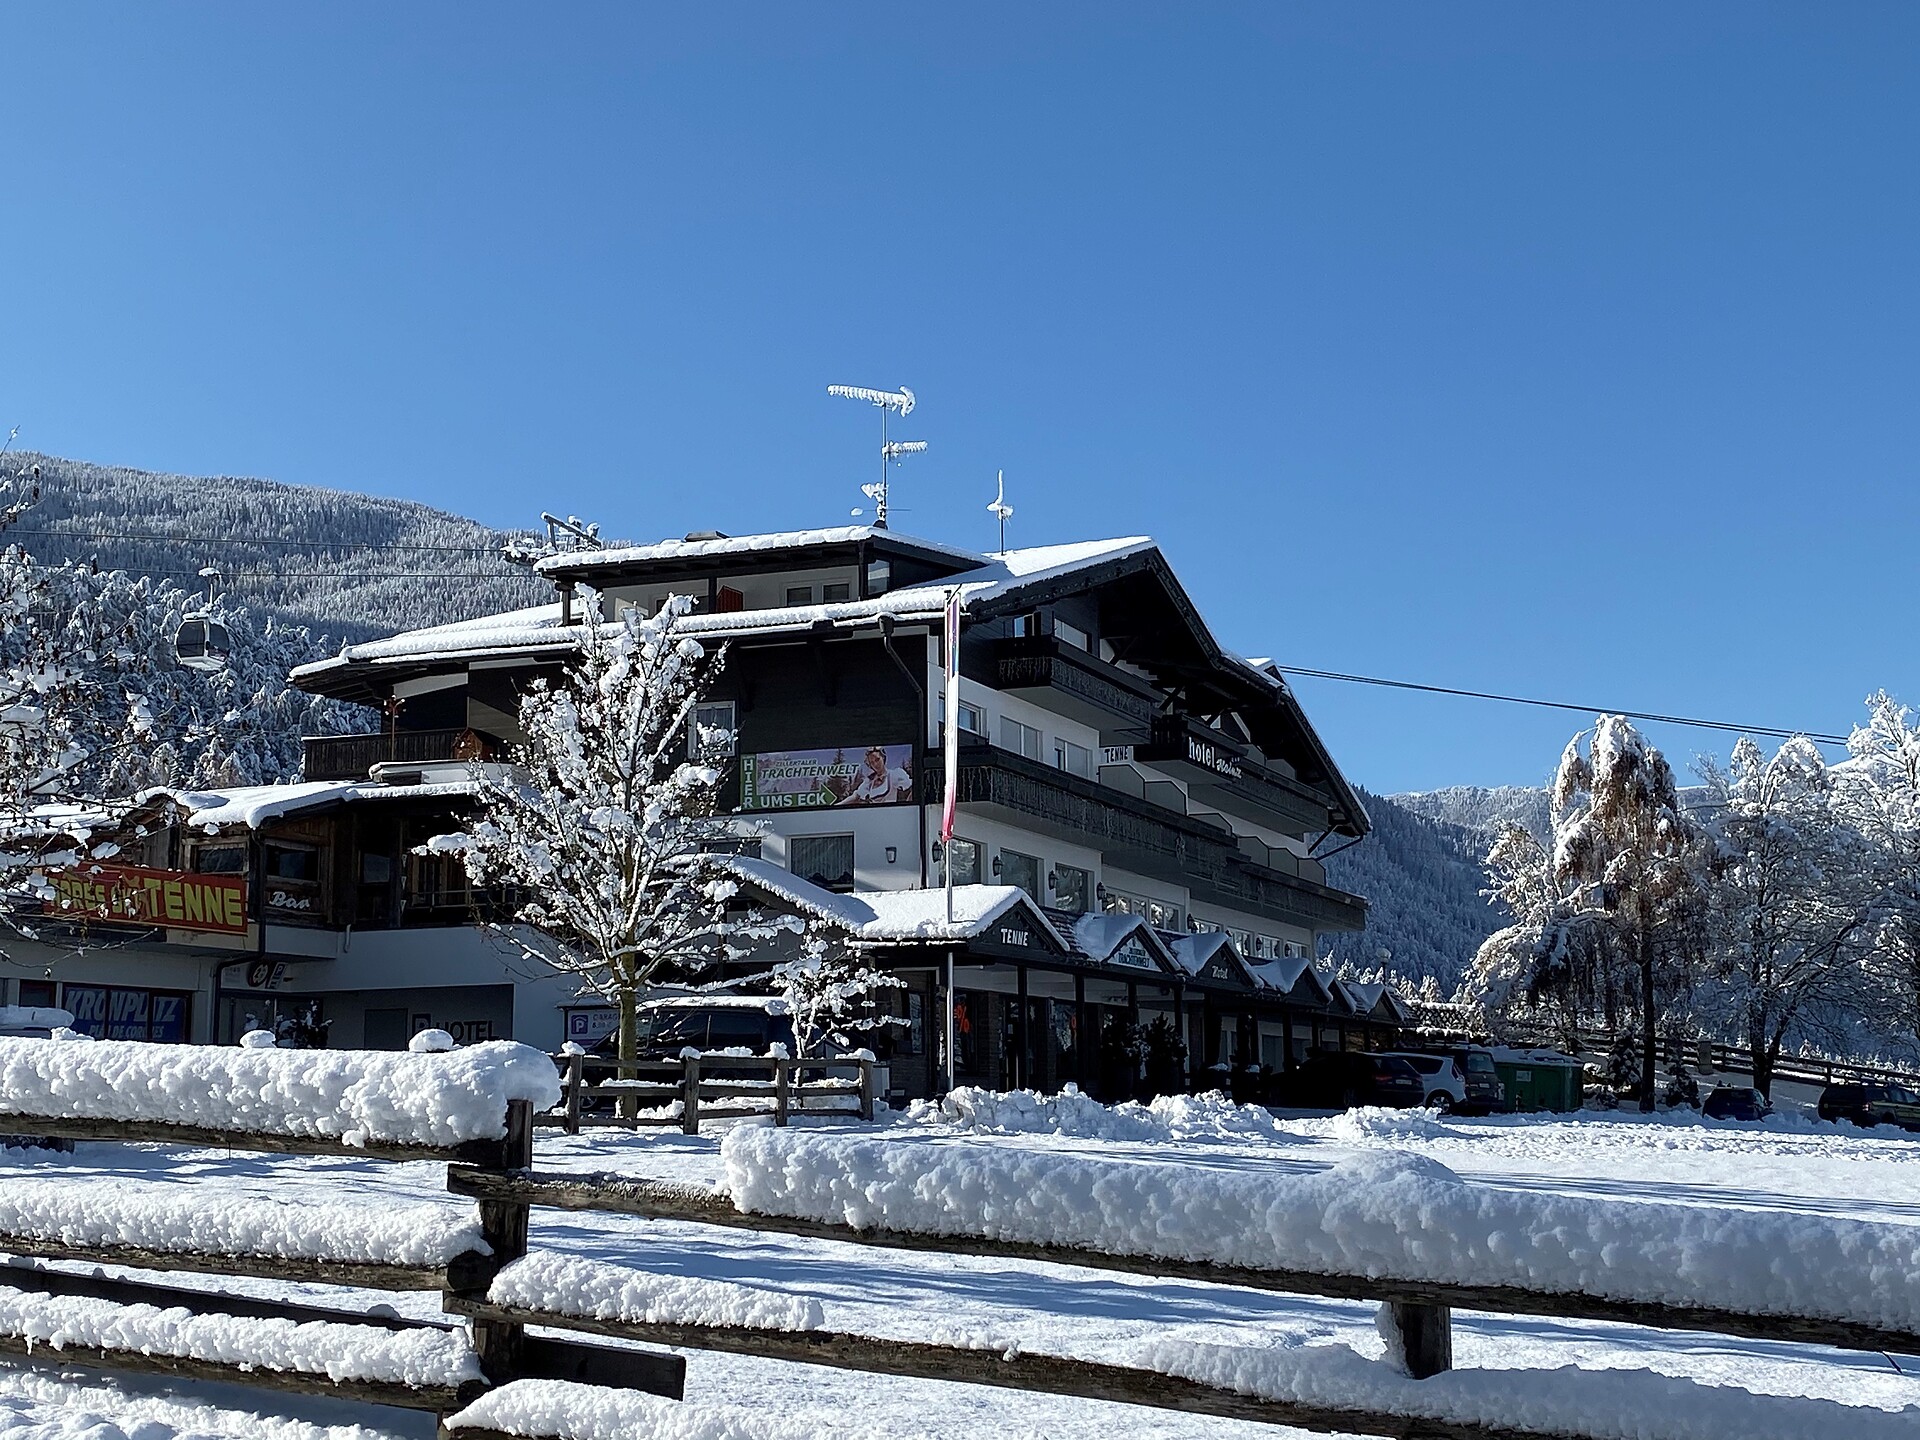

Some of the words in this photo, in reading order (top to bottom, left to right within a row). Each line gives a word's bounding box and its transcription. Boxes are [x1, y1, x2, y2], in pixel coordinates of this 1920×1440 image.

[1104, 747, 1128, 763] TENNE
[1188, 736, 1215, 768] hotel
[761, 764, 859, 779] TRACHTENWELT
[775, 758, 817, 768] ZILLERTALER
[743, 759, 754, 808] HIER
[760, 794, 793, 808] UMS
[797, 792, 827, 806] ECK
[143, 878, 243, 927] TENNE
[1000, 928, 1029, 947] TENNE
[64, 990, 179, 1022] KRONPLTZ
